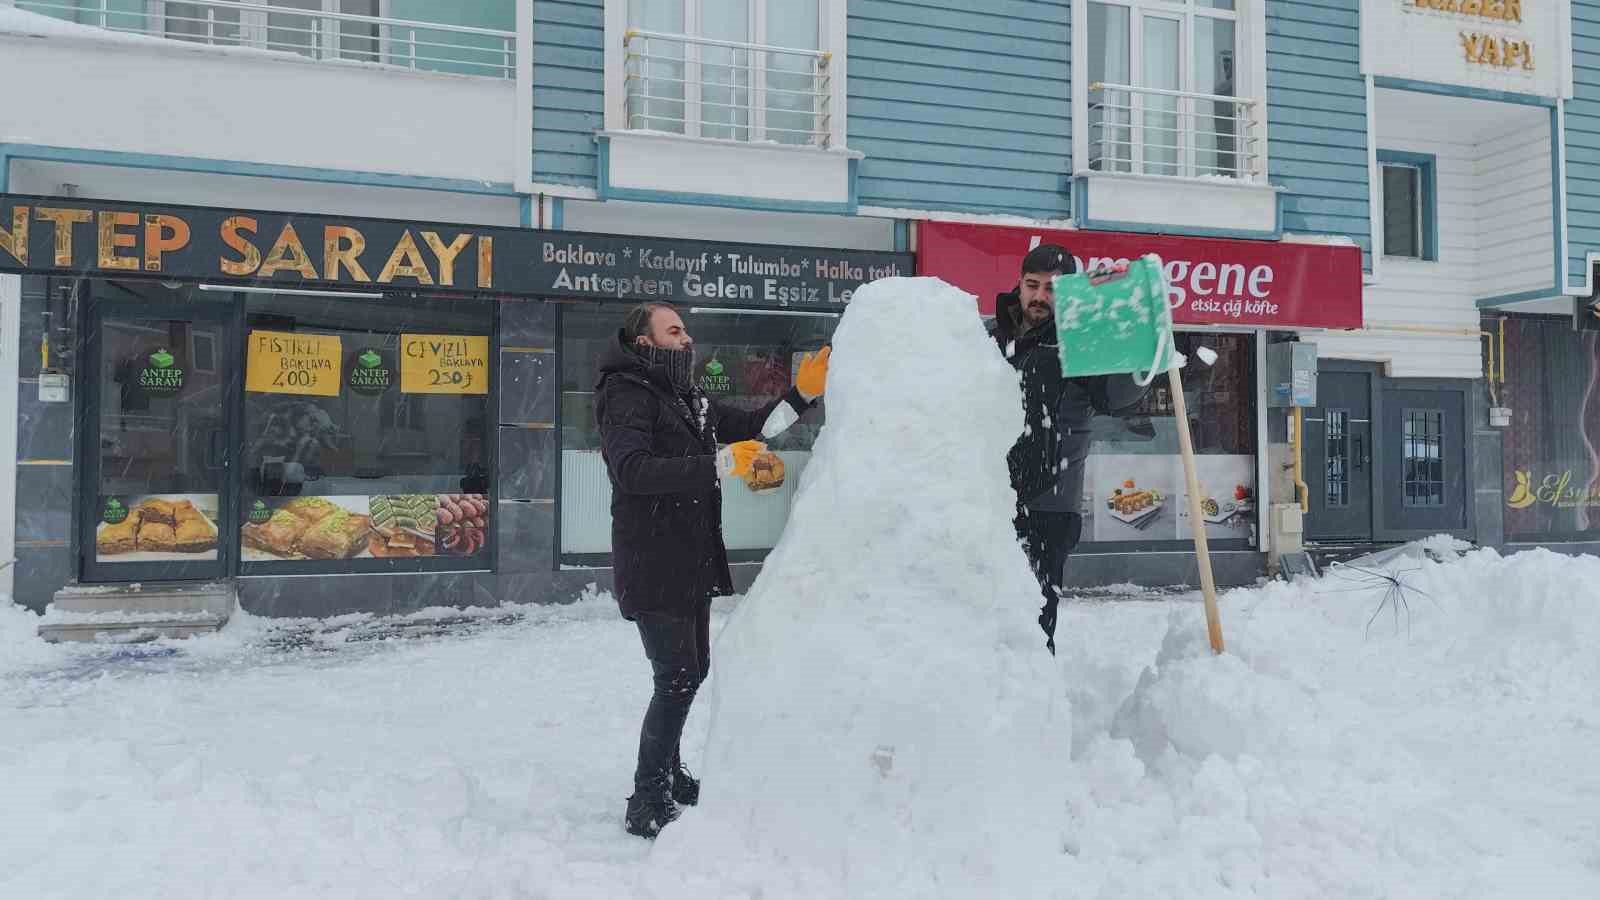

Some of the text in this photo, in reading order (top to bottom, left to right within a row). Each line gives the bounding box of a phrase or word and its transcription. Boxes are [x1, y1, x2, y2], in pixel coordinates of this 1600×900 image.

[1458, 31, 1536, 71] YAPI
[220, 215, 493, 288] SARAYI
[543, 242, 616, 266] Baklava
[639, 248, 708, 272] Kadayıf
[728, 253, 800, 277] Tulumba
[815, 259, 863, 280] Halka
[552, 267, 672, 298] Antepten
[682, 273, 754, 298] Gelen
[764, 279, 819, 307] Eşsiz
[1191, 299, 1279, 317] etsiz çiğ köfte
[258, 336, 321, 355] FISTIKLI
[280, 357, 332, 371] BAKLAVA
[141, 368, 183, 378] ANTEP
[352, 368, 389, 377] ANTEP
[700, 375, 731, 384] ANTEP
[140, 377, 182, 387] SARAYI
[351, 377, 389, 385] SARAYI
